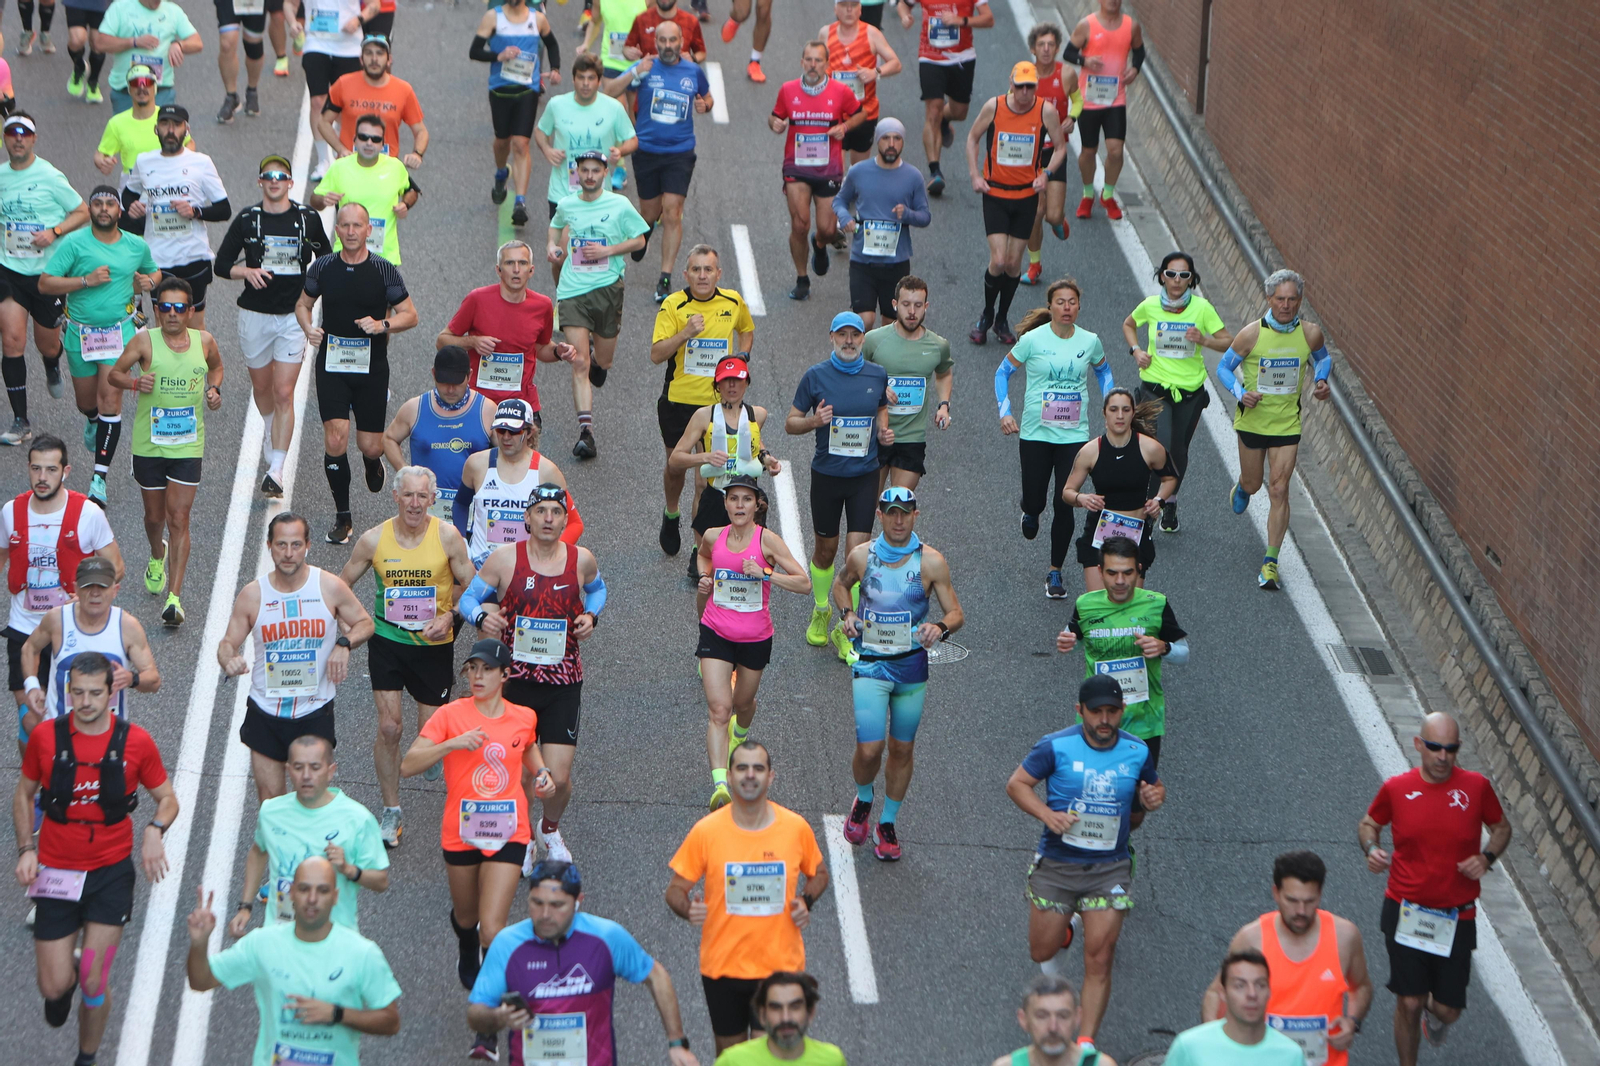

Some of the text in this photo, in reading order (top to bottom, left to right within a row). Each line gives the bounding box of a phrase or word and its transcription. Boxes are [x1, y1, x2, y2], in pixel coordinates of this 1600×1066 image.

[350, 100, 381, 109] 21.097
[806, 111, 833, 119] Lentos
[160, 377, 186, 386] Fisio
[386, 570, 431, 578] BROTHERS
[261, 619, 326, 643] MADRID
[1090, 625, 1146, 637] MEDIO MARATÓN
[1112, 662, 1139, 670] ZURICH
[1089, 804, 1117, 814] ZURICH
[747, 866, 778, 874] ZURICH
[544, 1019, 577, 1027] ZURICH
